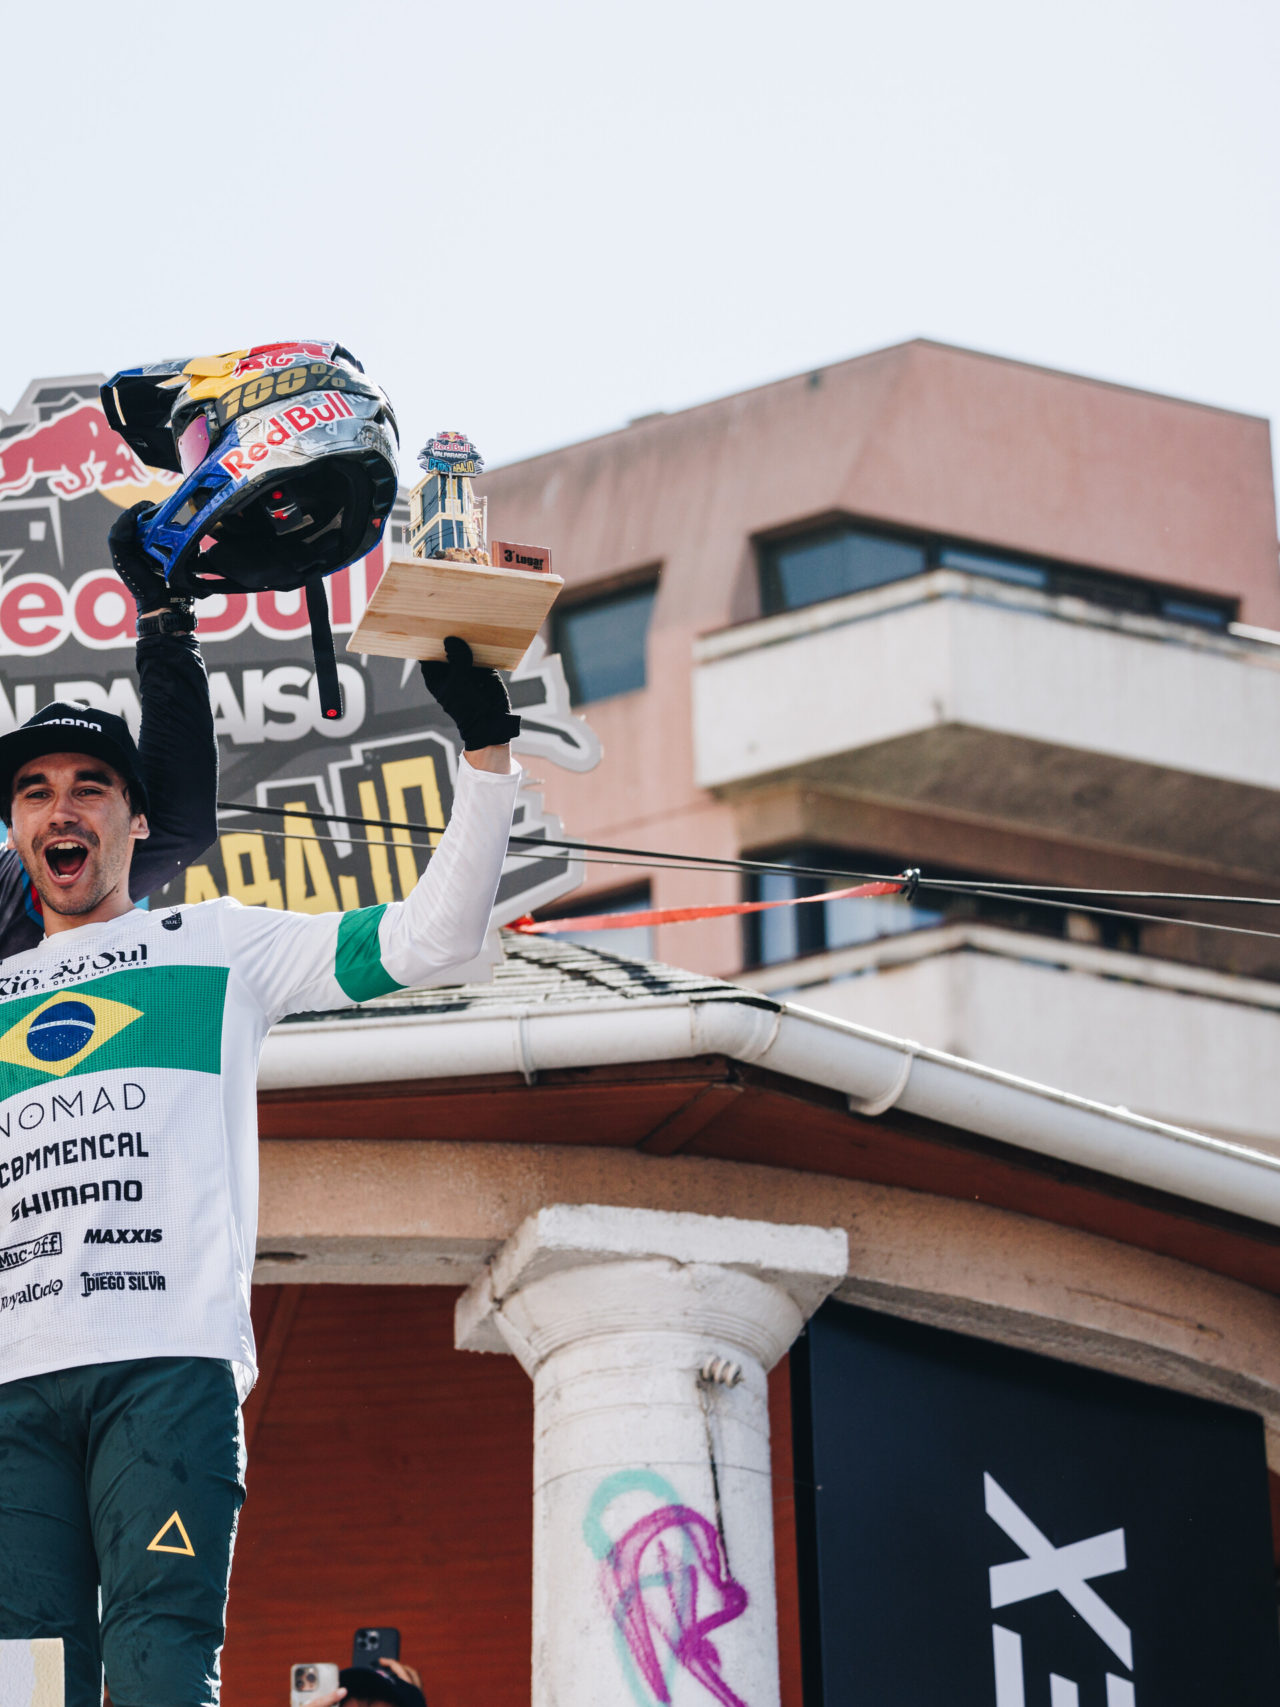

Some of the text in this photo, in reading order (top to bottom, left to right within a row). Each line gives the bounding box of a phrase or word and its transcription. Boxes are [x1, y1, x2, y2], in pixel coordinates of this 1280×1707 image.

[222, 362, 346, 421] 100%
[220, 391, 354, 480] Red Bull
[515, 554, 544, 566] Lugar
[10, 1179, 143, 1223] SHIMANO
[83, 1228, 163, 1244] MAXXIS
[86, 1275, 166, 1292] DIEGO SILVA
